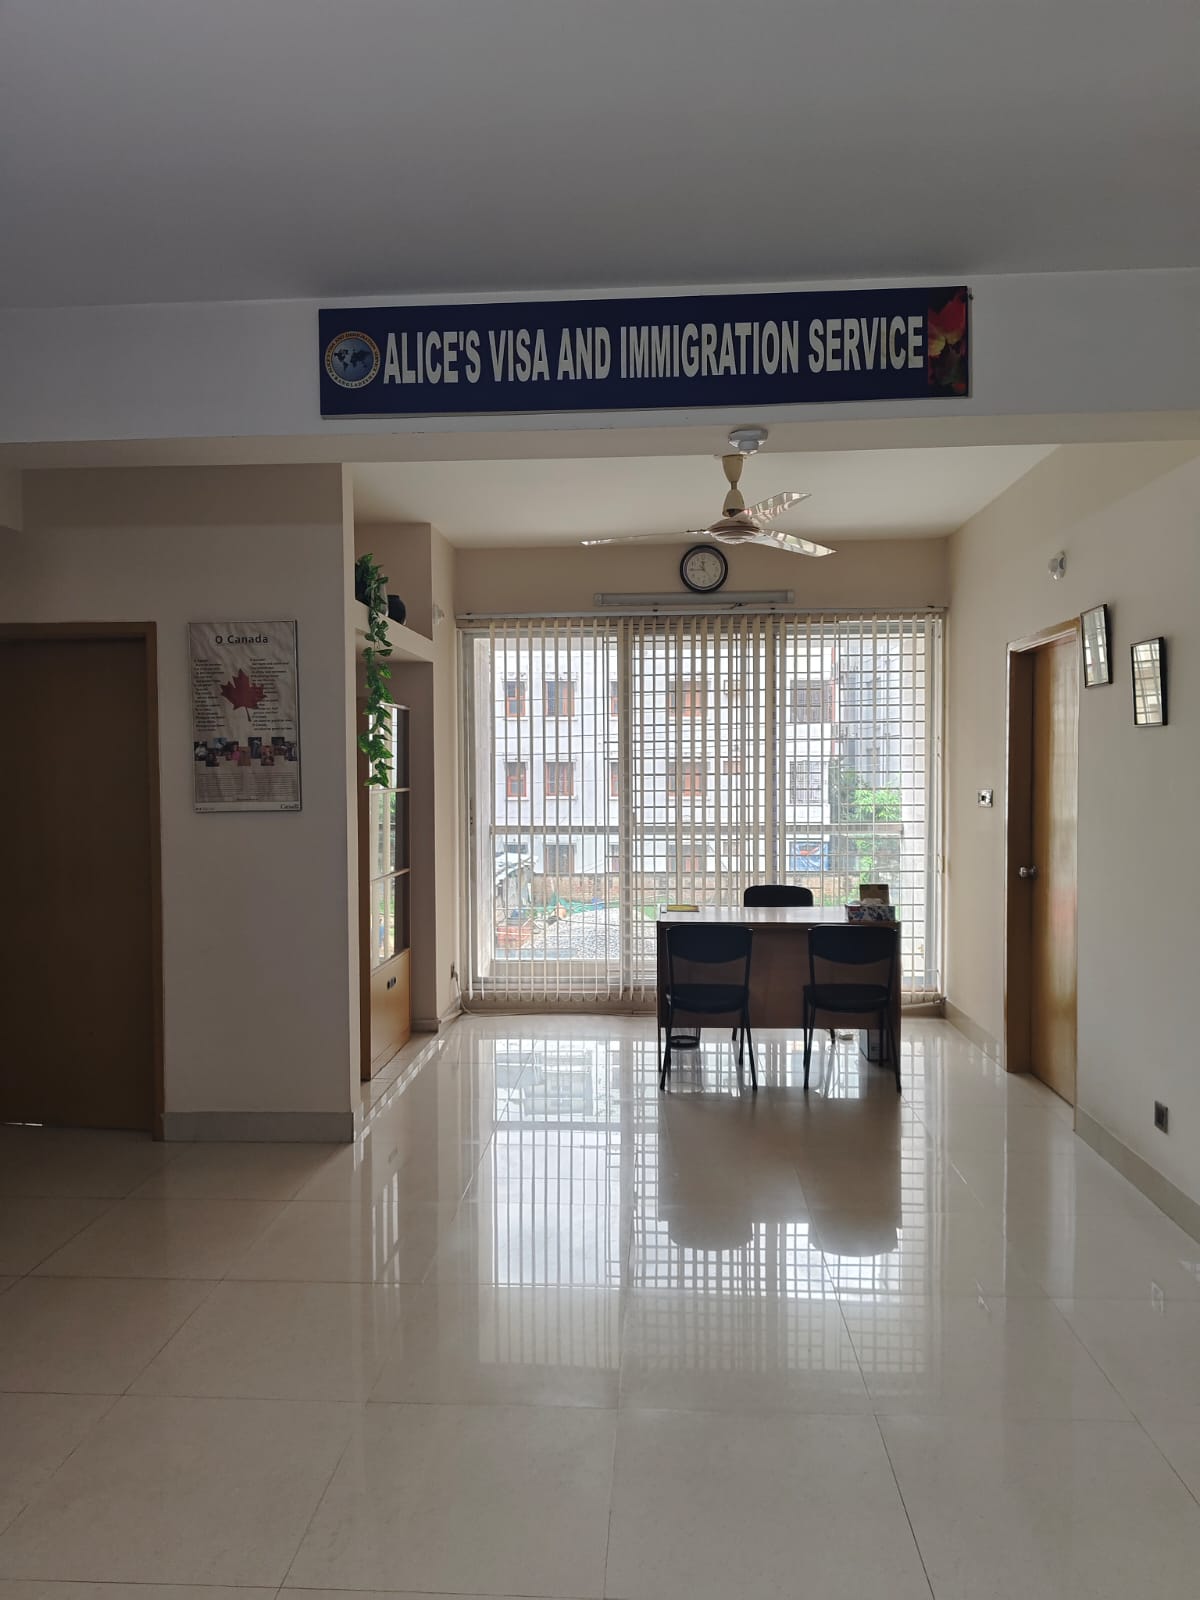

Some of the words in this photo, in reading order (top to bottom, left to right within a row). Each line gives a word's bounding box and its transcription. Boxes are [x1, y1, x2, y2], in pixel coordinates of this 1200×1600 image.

[383, 330, 481, 384] ALICE'S
[488, 328, 550, 382] VISA
[557, 326, 611, 380] AND
[620, 320, 800, 379] IMMIGRATION
[808, 315, 924, 373] SERVICE
[215, 635, 223, 645] O
[227, 633, 269, 644] Canada
